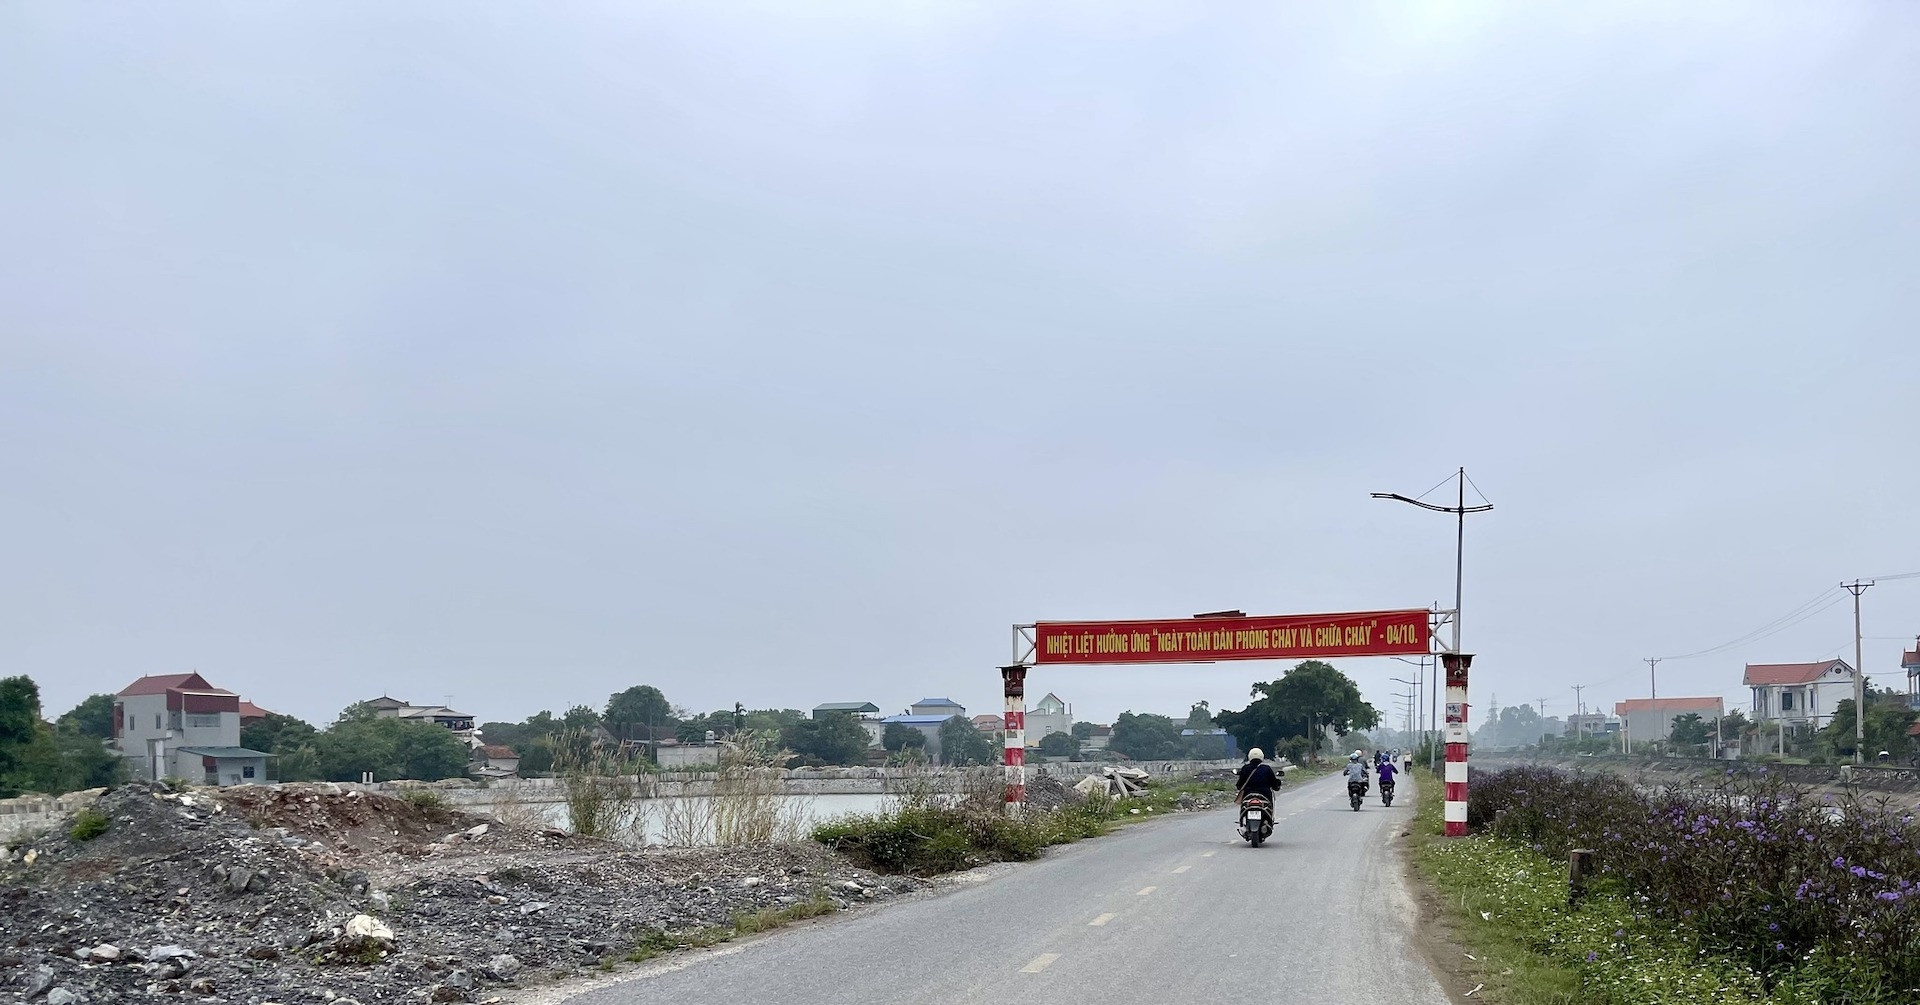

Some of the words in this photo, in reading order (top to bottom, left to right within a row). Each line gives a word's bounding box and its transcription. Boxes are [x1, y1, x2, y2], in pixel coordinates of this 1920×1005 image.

[1046, 631, 1074, 658] NHIỆT
[1075, 631, 1094, 658] LIỆT
[1096, 628, 1129, 654] HƯỞNG
[1130, 628, 1150, 653] ỨNG
[1186, 628, 1211, 651] TOÀN
[1213, 627, 1233, 650] DÂN
[1235, 625, 1269, 650] PHÒNG
[1271, 625, 1298, 649] CHÁY
[1299, 624, 1313, 648] VÀ
[1315, 623, 1343, 647] CHỮA
[1386, 624, 1418, 645] 04/10.
